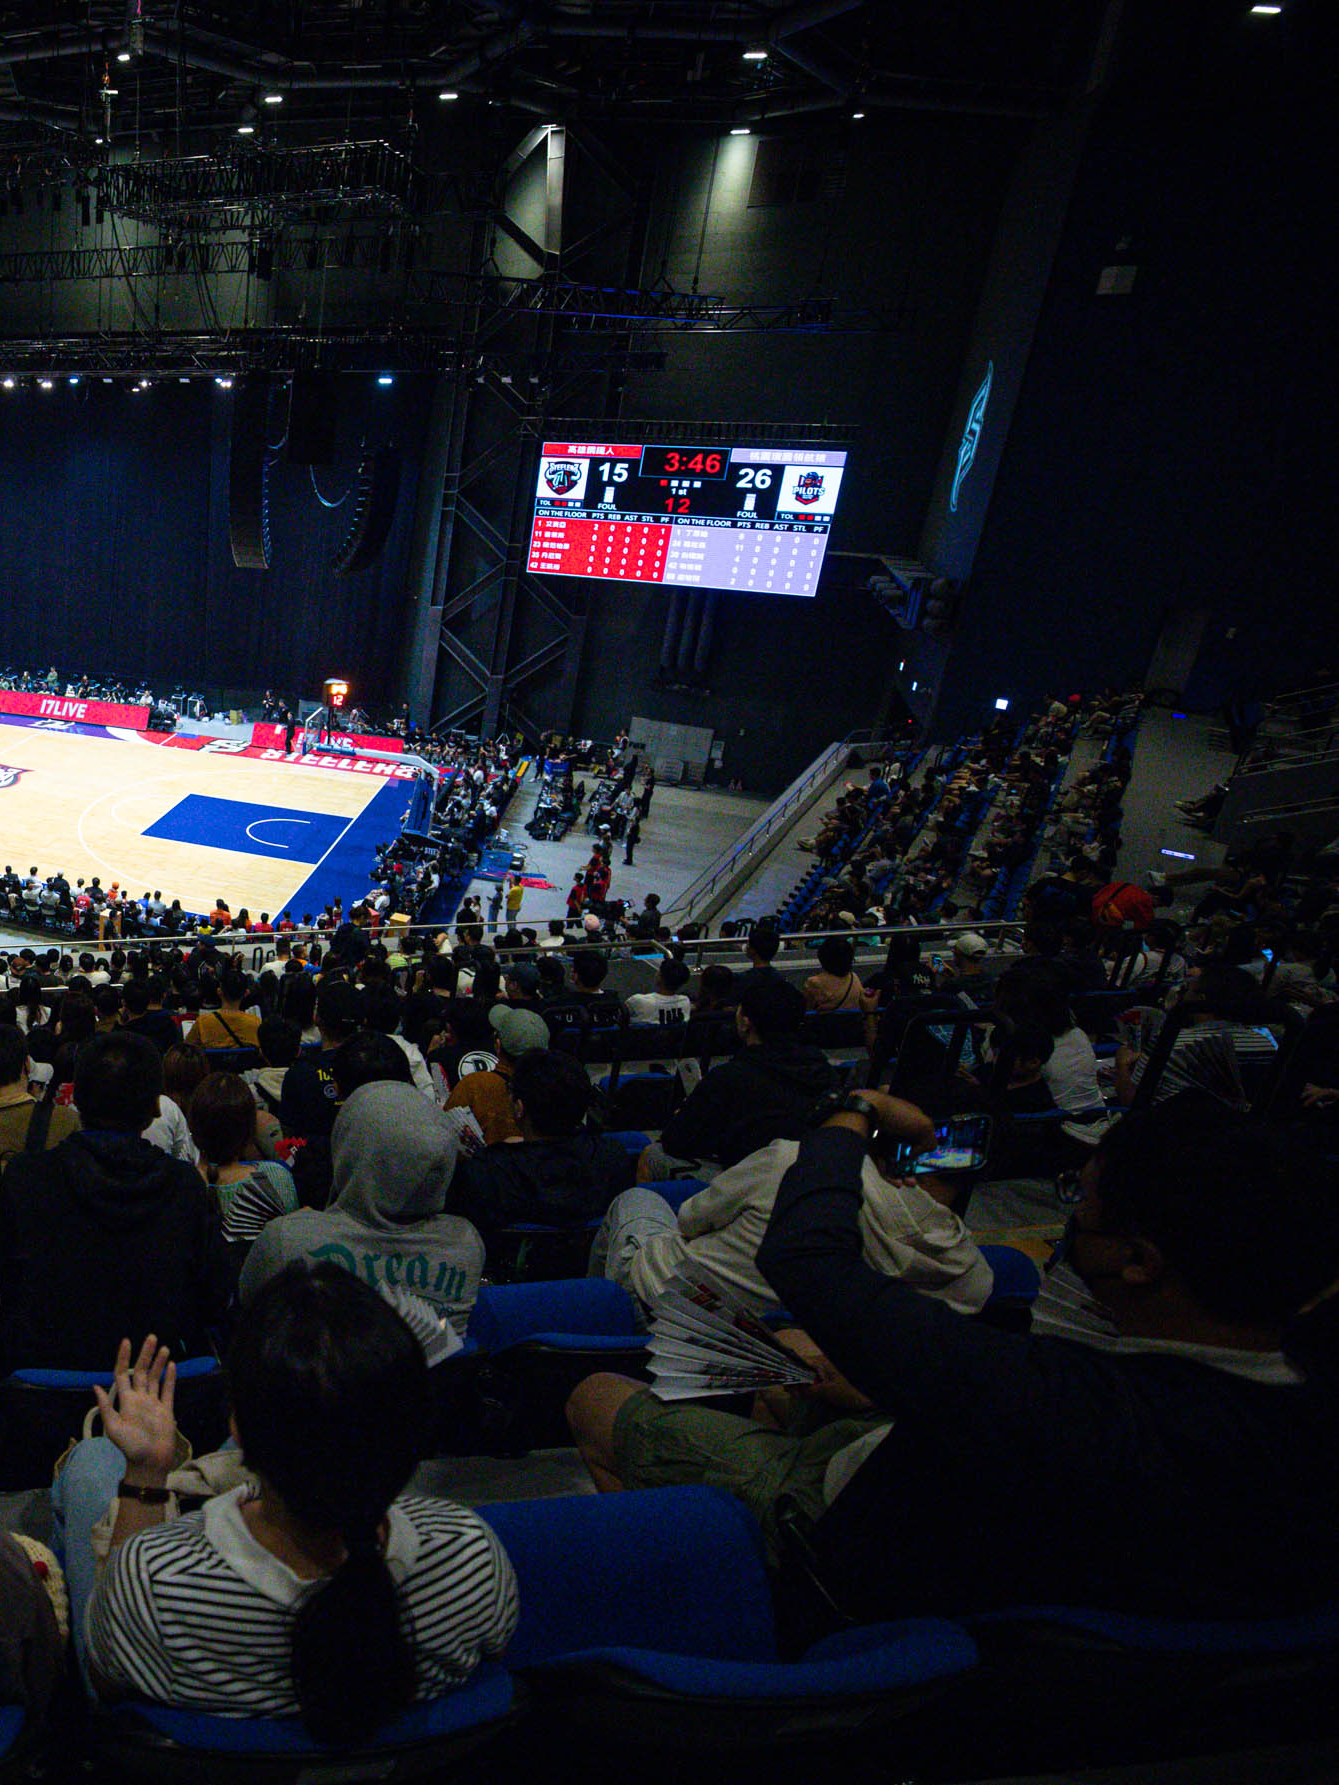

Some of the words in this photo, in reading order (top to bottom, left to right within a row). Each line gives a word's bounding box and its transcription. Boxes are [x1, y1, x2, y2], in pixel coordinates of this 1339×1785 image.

[599, 462, 629, 482] 15
[664, 452, 722, 474] 3:46
[736, 468, 772, 489] 26
[792, 486, 825, 495] PILOTS
[665, 498, 690, 513] 12
[40, 699, 88, 718] 17LIVE
[333, 695, 344, 706] 12
